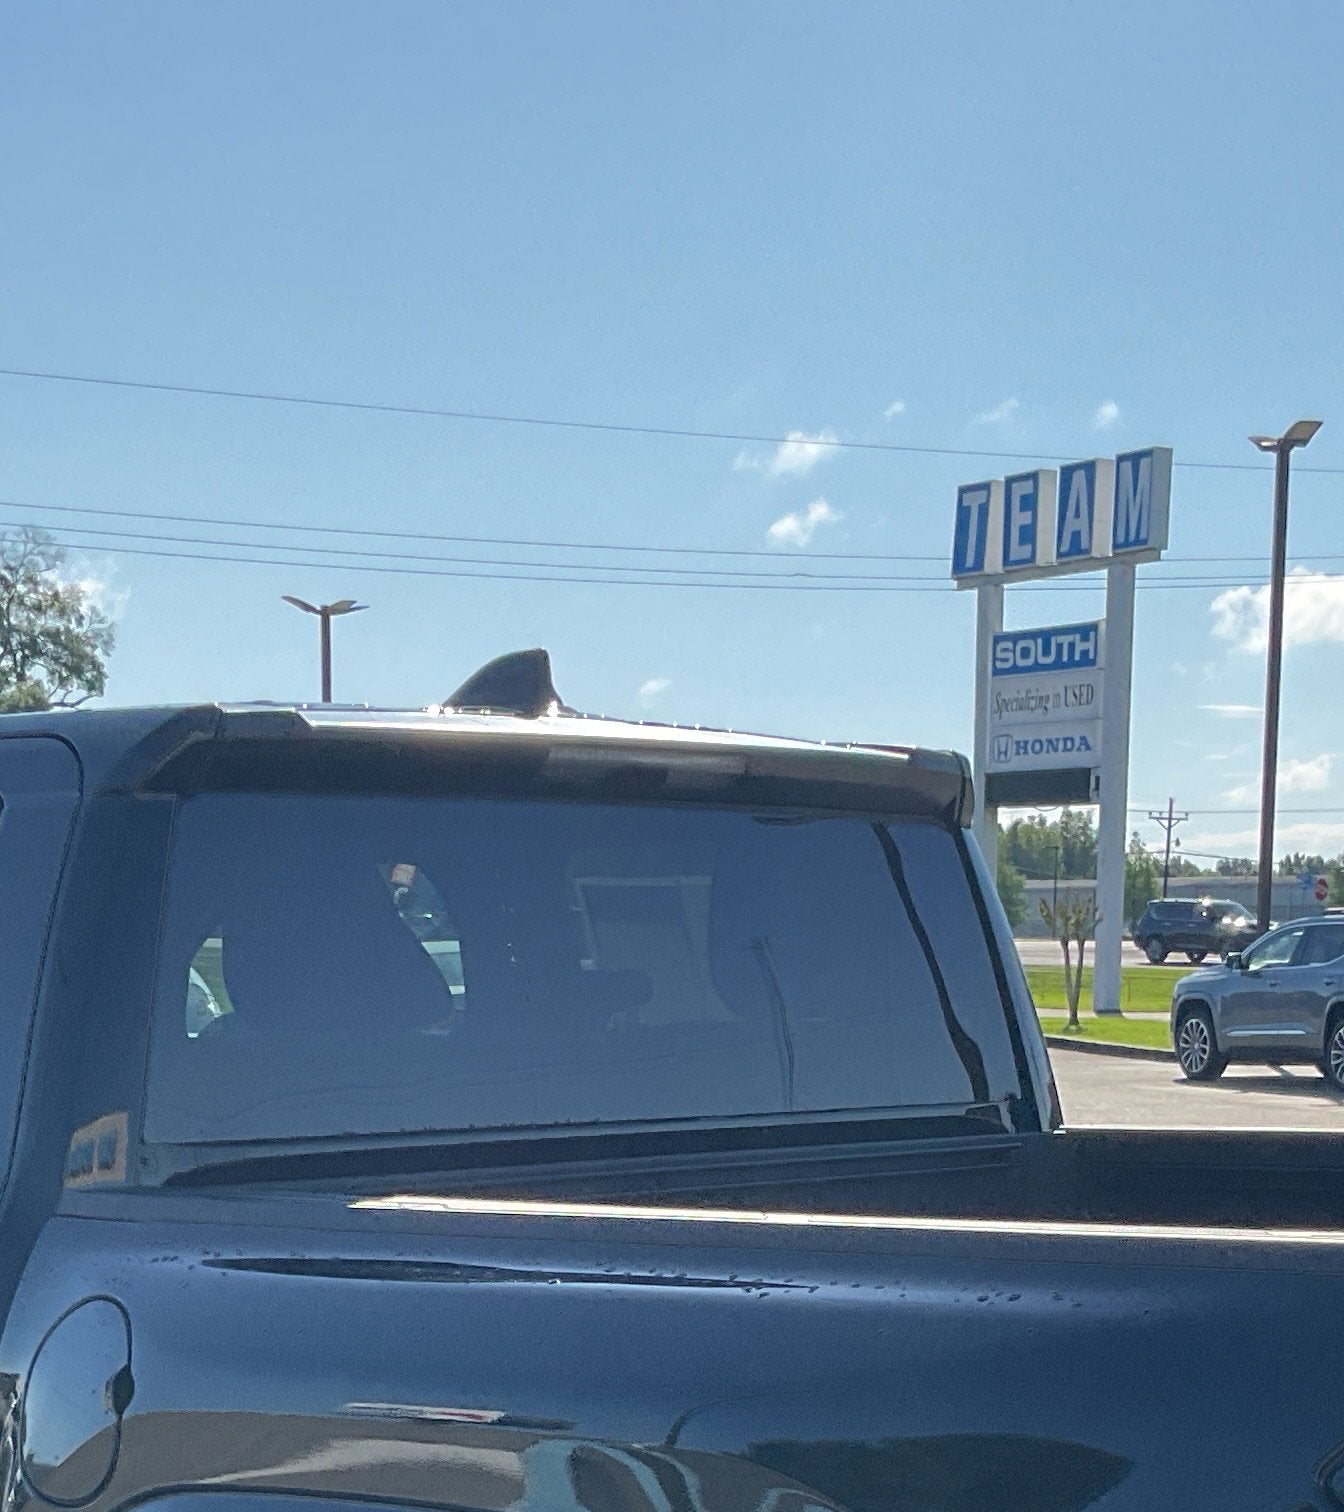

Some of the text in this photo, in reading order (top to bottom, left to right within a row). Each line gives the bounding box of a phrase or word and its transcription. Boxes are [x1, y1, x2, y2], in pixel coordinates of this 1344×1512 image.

[961, 457, 1152, 568] TEAM
[995, 631, 1096, 669] SOUTH
[994, 688, 1050, 720] Specializing
[1064, 684, 1094, 708] USED
[1014, 735, 1093, 756] HONDA
